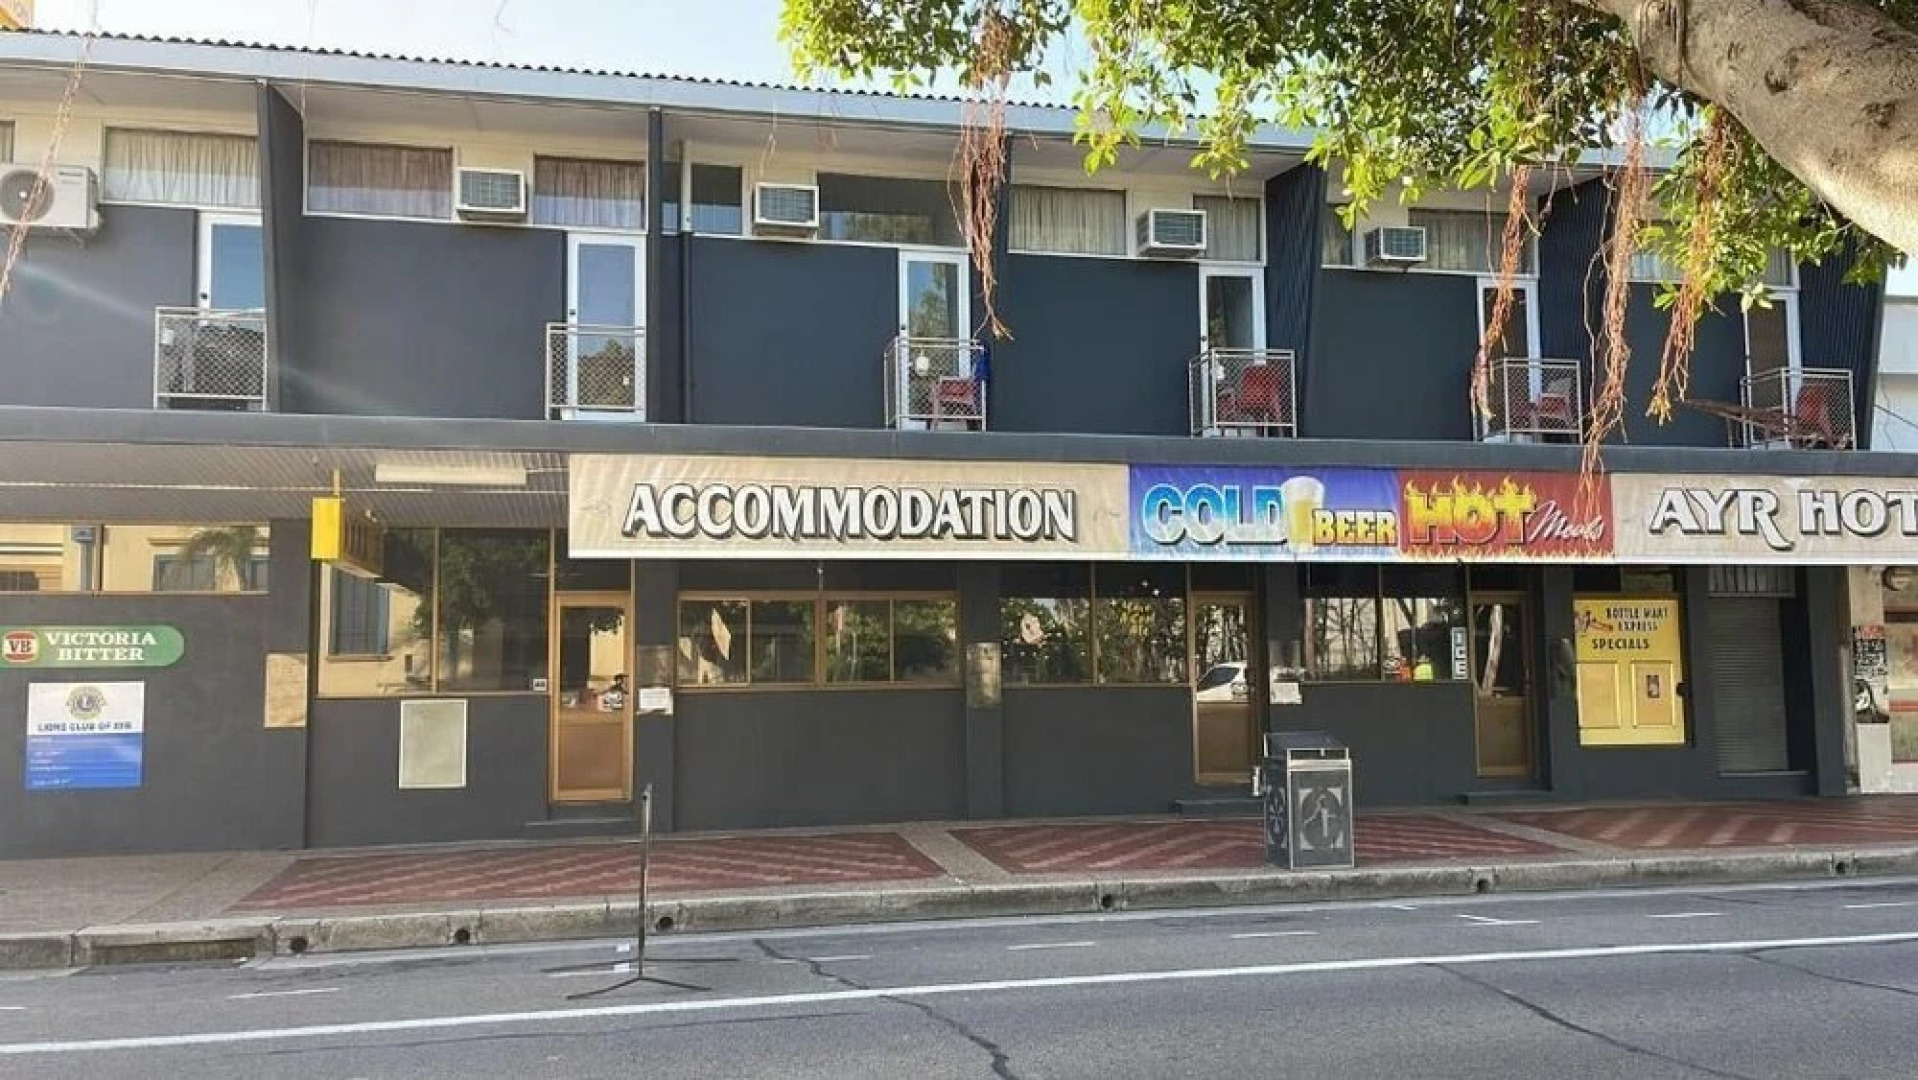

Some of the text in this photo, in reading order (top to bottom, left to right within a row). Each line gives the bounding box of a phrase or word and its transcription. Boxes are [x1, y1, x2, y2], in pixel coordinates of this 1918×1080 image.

[621, 482, 1079, 544] ACCOMMODATION
[1142, 483, 1398, 547] COLD BEER
[1404, 478, 1537, 545] HOT
[1649, 487, 1796, 551] AYR
[1606, 607, 1668, 619] BOTTLE MART
[1618, 621, 1658, 631] EXPRESS
[44, 631, 157, 646] VICTORIA
[1591, 638, 1649, 649] SPECIALS
[8, 639, 33, 654] VB
[57, 647, 145, 661] BITTER
[1453, 631, 1468, 678] ICE
[38, 722, 67, 732] LIONS
[69, 722, 96, 732] CLUB
